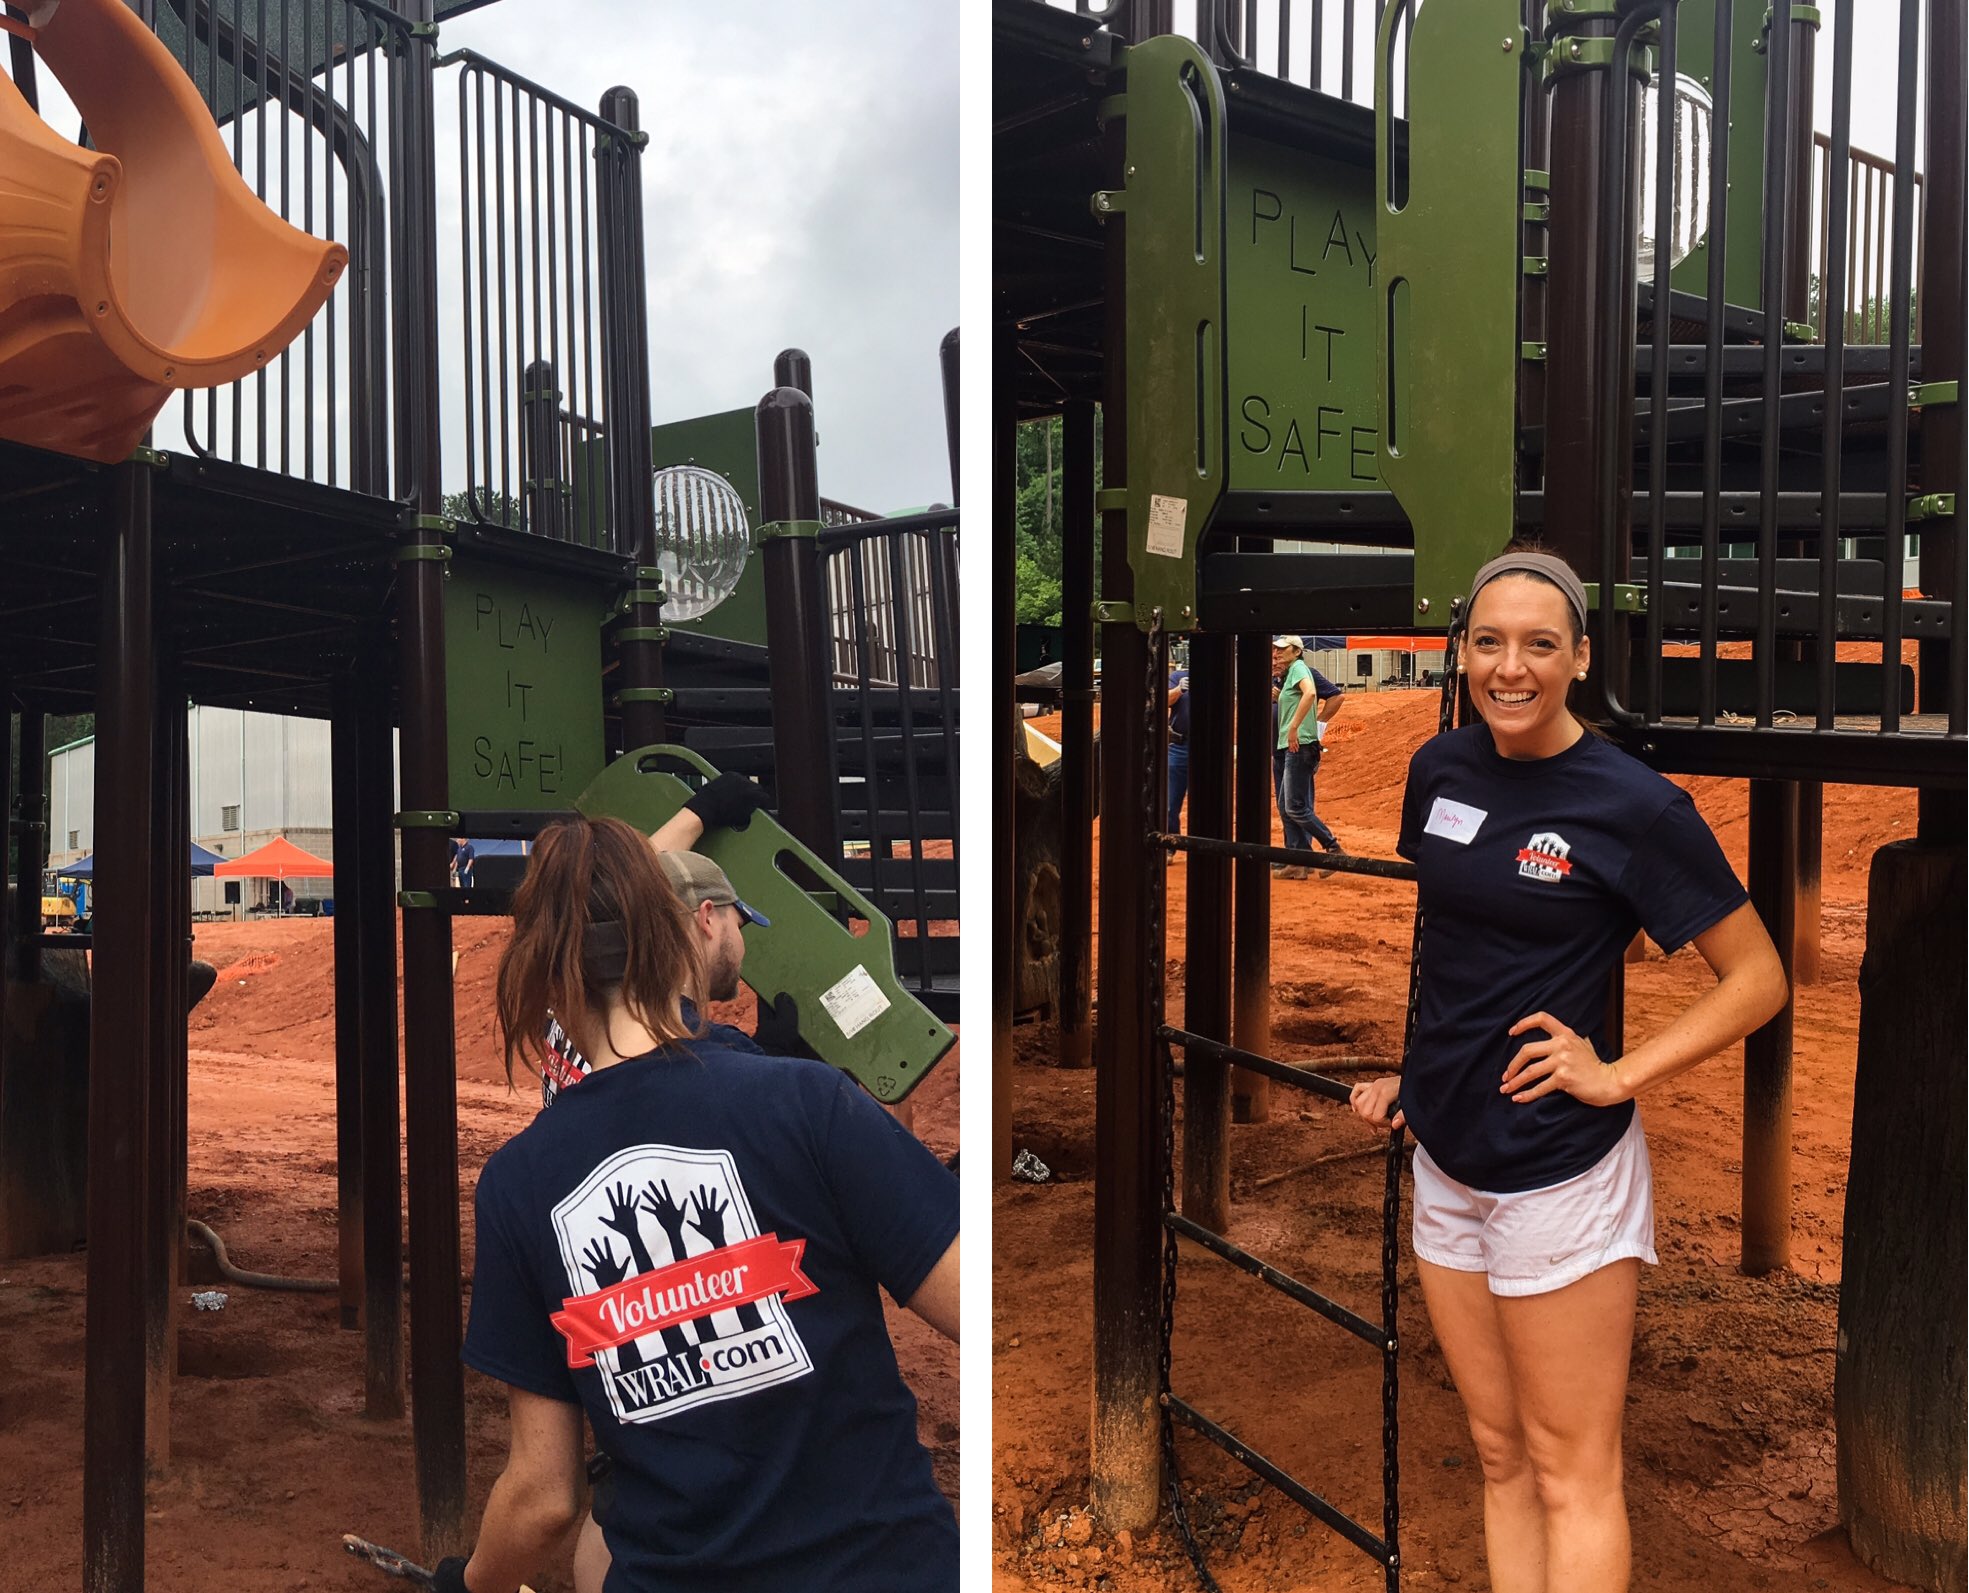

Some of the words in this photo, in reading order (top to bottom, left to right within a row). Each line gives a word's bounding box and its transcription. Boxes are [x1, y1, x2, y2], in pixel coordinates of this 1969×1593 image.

[1252, 187, 1377, 288] PLAY
[1302, 304, 1346, 383] IT
[1241, 395, 1378, 482] SAFE
[476, 592, 554, 654] PLAY
[507, 669, 533, 723] IT
[474, 736, 564, 794] SAFE!
[600, 1264, 749, 1335] Volunteer
